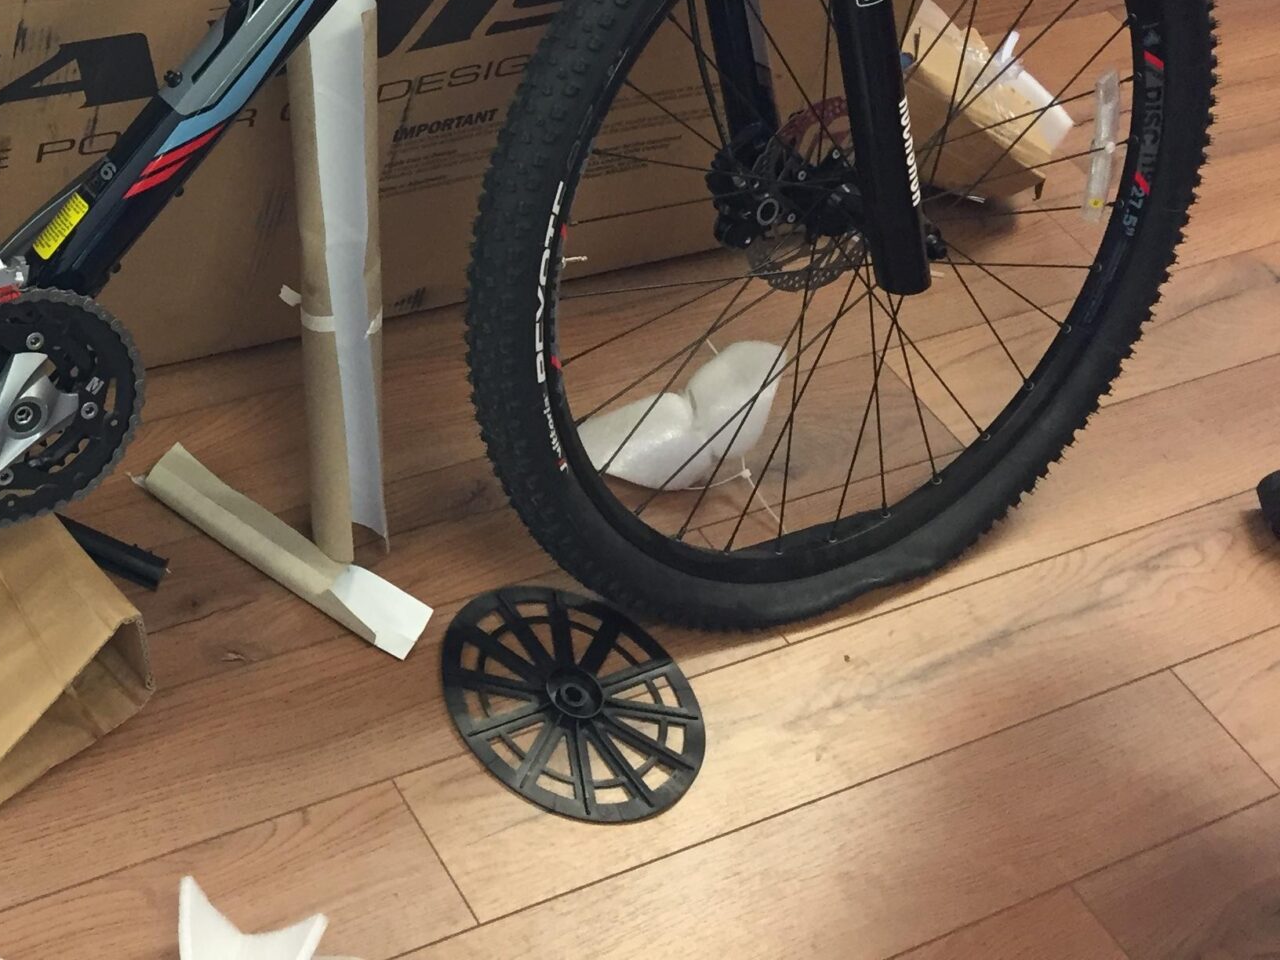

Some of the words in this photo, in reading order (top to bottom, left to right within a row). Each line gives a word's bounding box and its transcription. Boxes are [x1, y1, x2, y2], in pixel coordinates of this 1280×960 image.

[377, 54, 532, 103] DESIG
[393, 109, 499, 142] IMPORTANT
[1122, 185, 1145, 237] 27.5"
